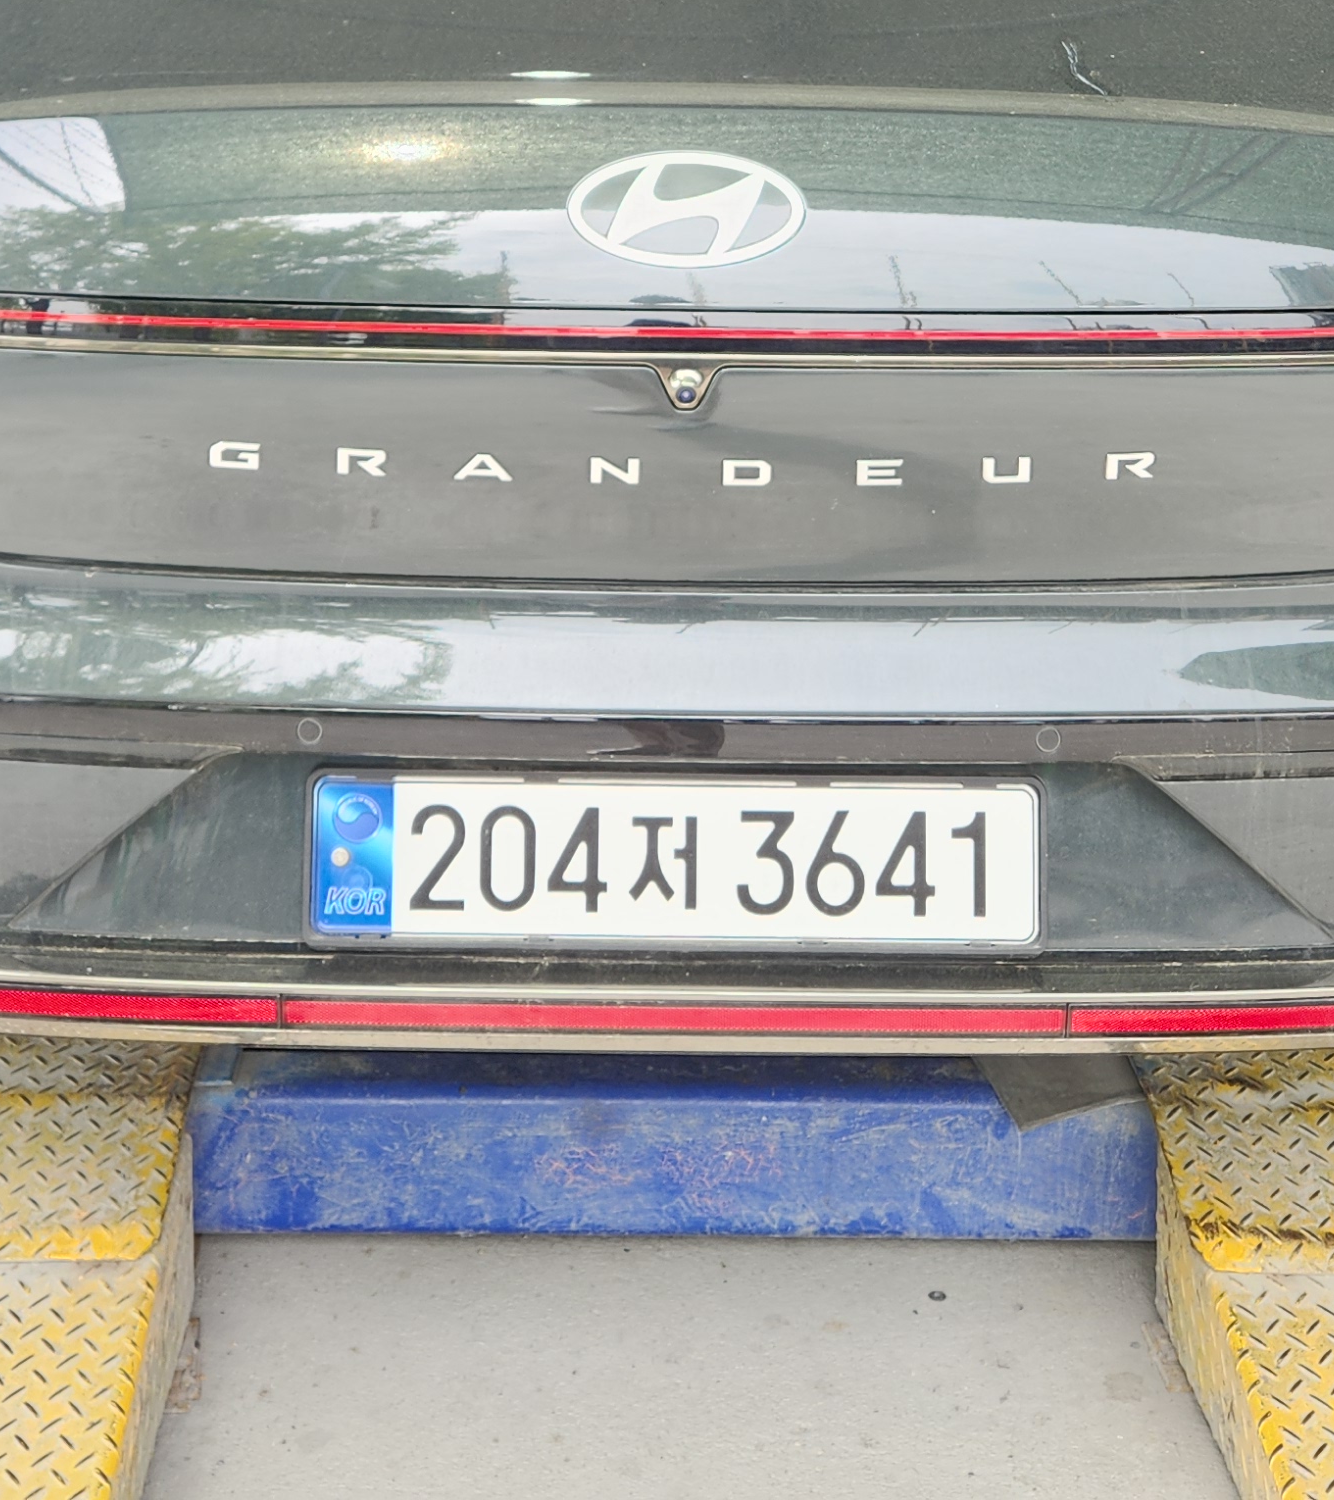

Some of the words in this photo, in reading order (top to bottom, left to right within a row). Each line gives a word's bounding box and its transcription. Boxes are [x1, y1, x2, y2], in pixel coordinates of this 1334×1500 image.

[208, 441, 1156, 487] GRANDEUR
[409, 804, 698, 913] 204저
[737, 809, 986, 917] 3641
[323, 886, 387, 916] KOR
